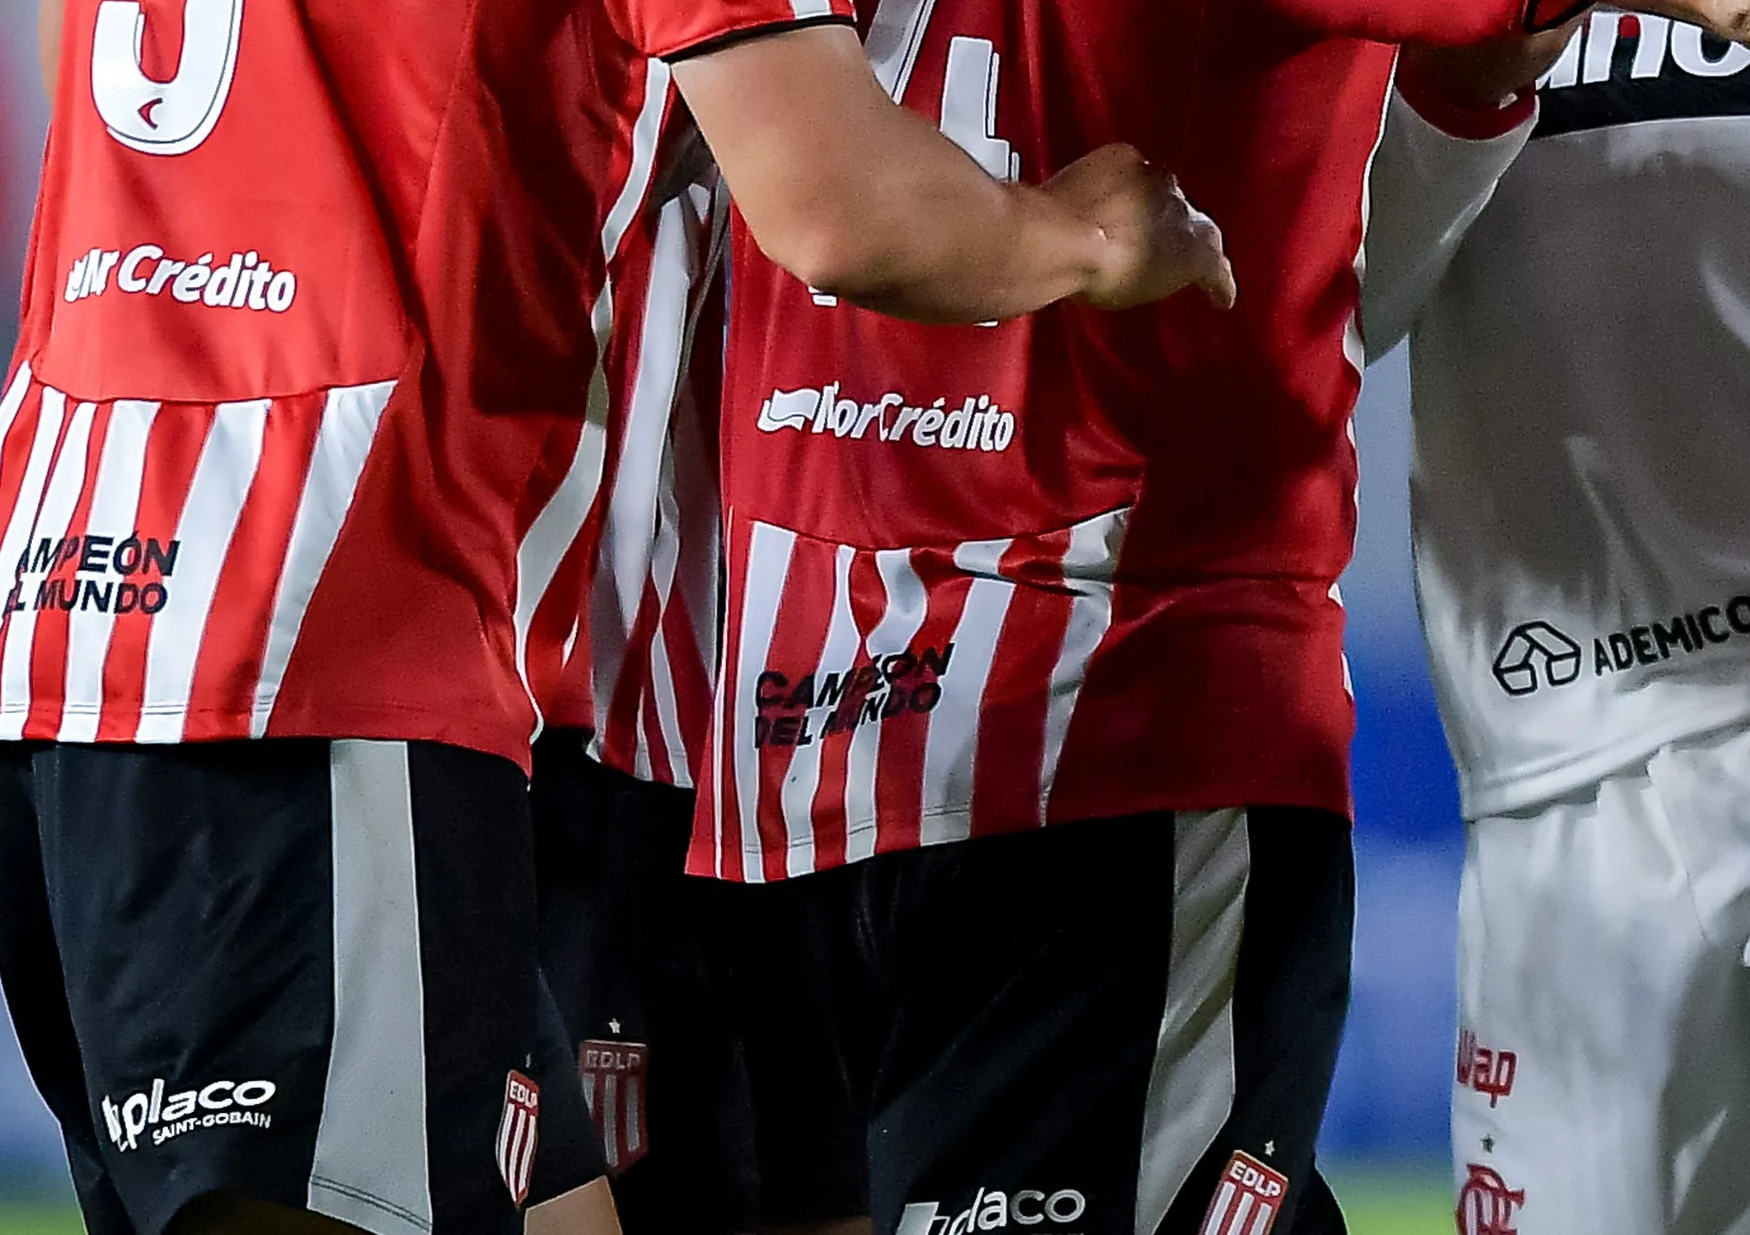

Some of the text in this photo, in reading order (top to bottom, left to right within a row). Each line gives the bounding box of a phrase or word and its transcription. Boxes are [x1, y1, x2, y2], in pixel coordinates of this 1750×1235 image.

[117, 244, 297, 312] Crédito
[33, 579, 168, 615] MUNDO
[586, 1049, 642, 1071] EDLP
[121, 1078, 277, 1150] placo
[152, 1111, 272, 1146] SAINT-GOBAIN
[1229, 1160, 1281, 1198] EDLP
